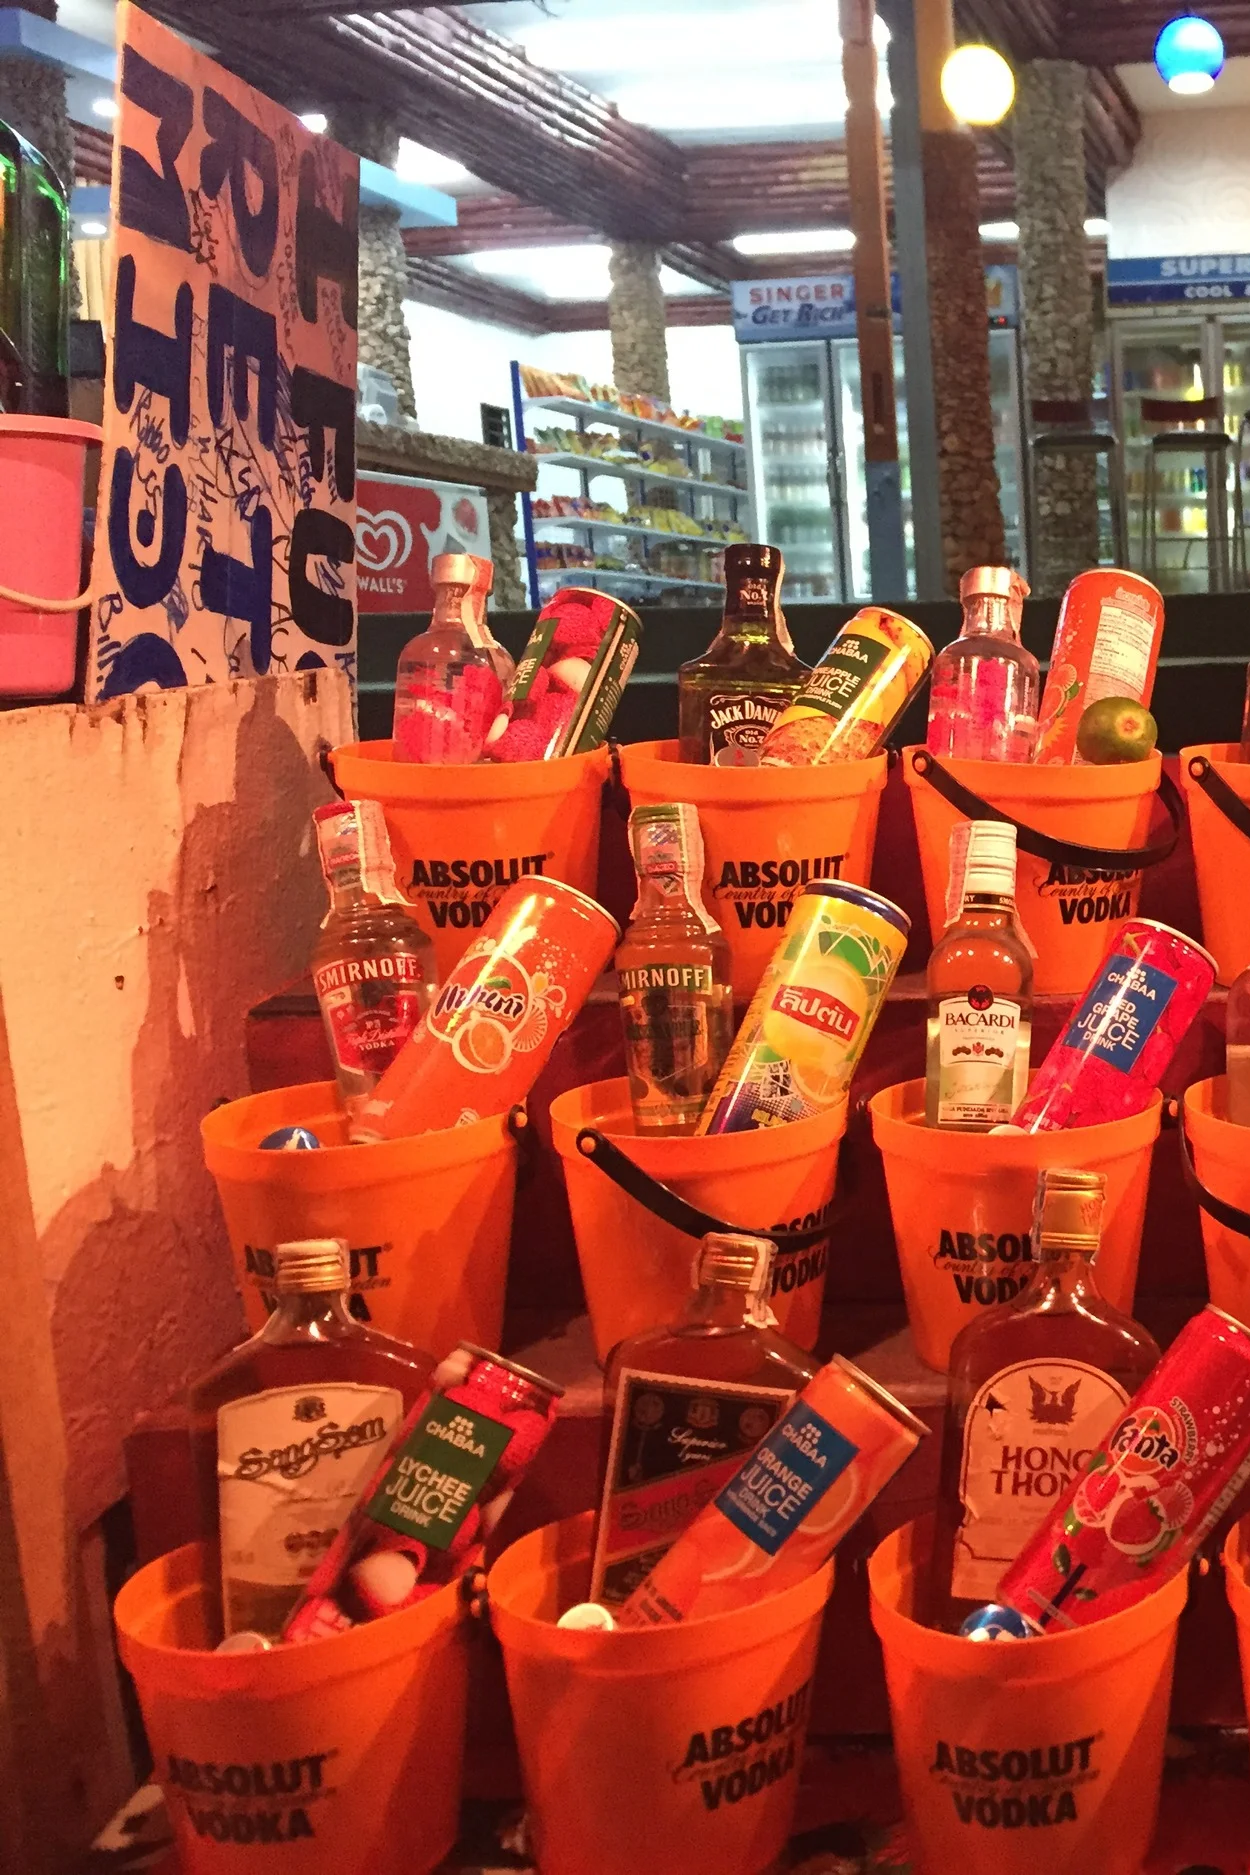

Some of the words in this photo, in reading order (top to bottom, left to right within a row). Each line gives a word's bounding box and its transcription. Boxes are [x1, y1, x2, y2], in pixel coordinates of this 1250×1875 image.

[749, 283, 845, 305] SINGER
[1185, 282, 1233, 298] COOL
[288, 366, 358, 672] FU
[356, 576, 405, 594] WALL'S
[709, 702, 742, 730] JACK
[744, 698, 781, 722] DANI
[411, 854, 548, 887] ABSOLUT
[718, 855, 844, 888] ABSOLUT
[427, 899, 501, 929] VOD
[733, 900, 796, 929] VOD
[1059, 890, 1132, 925] VODKA
[318, 956, 421, 992] SMIRNOFF
[778, 986, 854, 1036] ลิปตัน
[944, 1012, 1016, 1029] BACARDI
[1109, 995, 1137, 1015] ED
[359, 1039, 396, 1052] VODKA
[1077, 1012, 1140, 1052] JUCE
[244, 1243, 383, 1281] ABUT
[938, 1229, 1034, 1263] ABSOL
[425, 1420, 486, 1459] CHABAA
[781, 1422, 828, 1469] CHABAA
[1110, 1416, 1179, 1470] Fanta
[1170, 1396, 1199, 1466] STRAWBERRY
[397, 1455, 473, 1502] LYCHEE
[739, 1463, 803, 1521] JUICE
[756, 1446, 814, 1501] ORANGE
[990, 1469, 1074, 1498] THO
[385, 1476, 461, 1523] JUICE
[390, 1500, 433, 1528] DRINK
[738, 1486, 771, 1519] DRINK
[168, 1752, 328, 1797] ABSOLUT
[702, 1739, 796, 1810] VODKA
[933, 1735, 1096, 1783] ABSOLUT
[184, 1805, 316, 1844] VODKA
[951, 1791, 1078, 1829] VODKA
